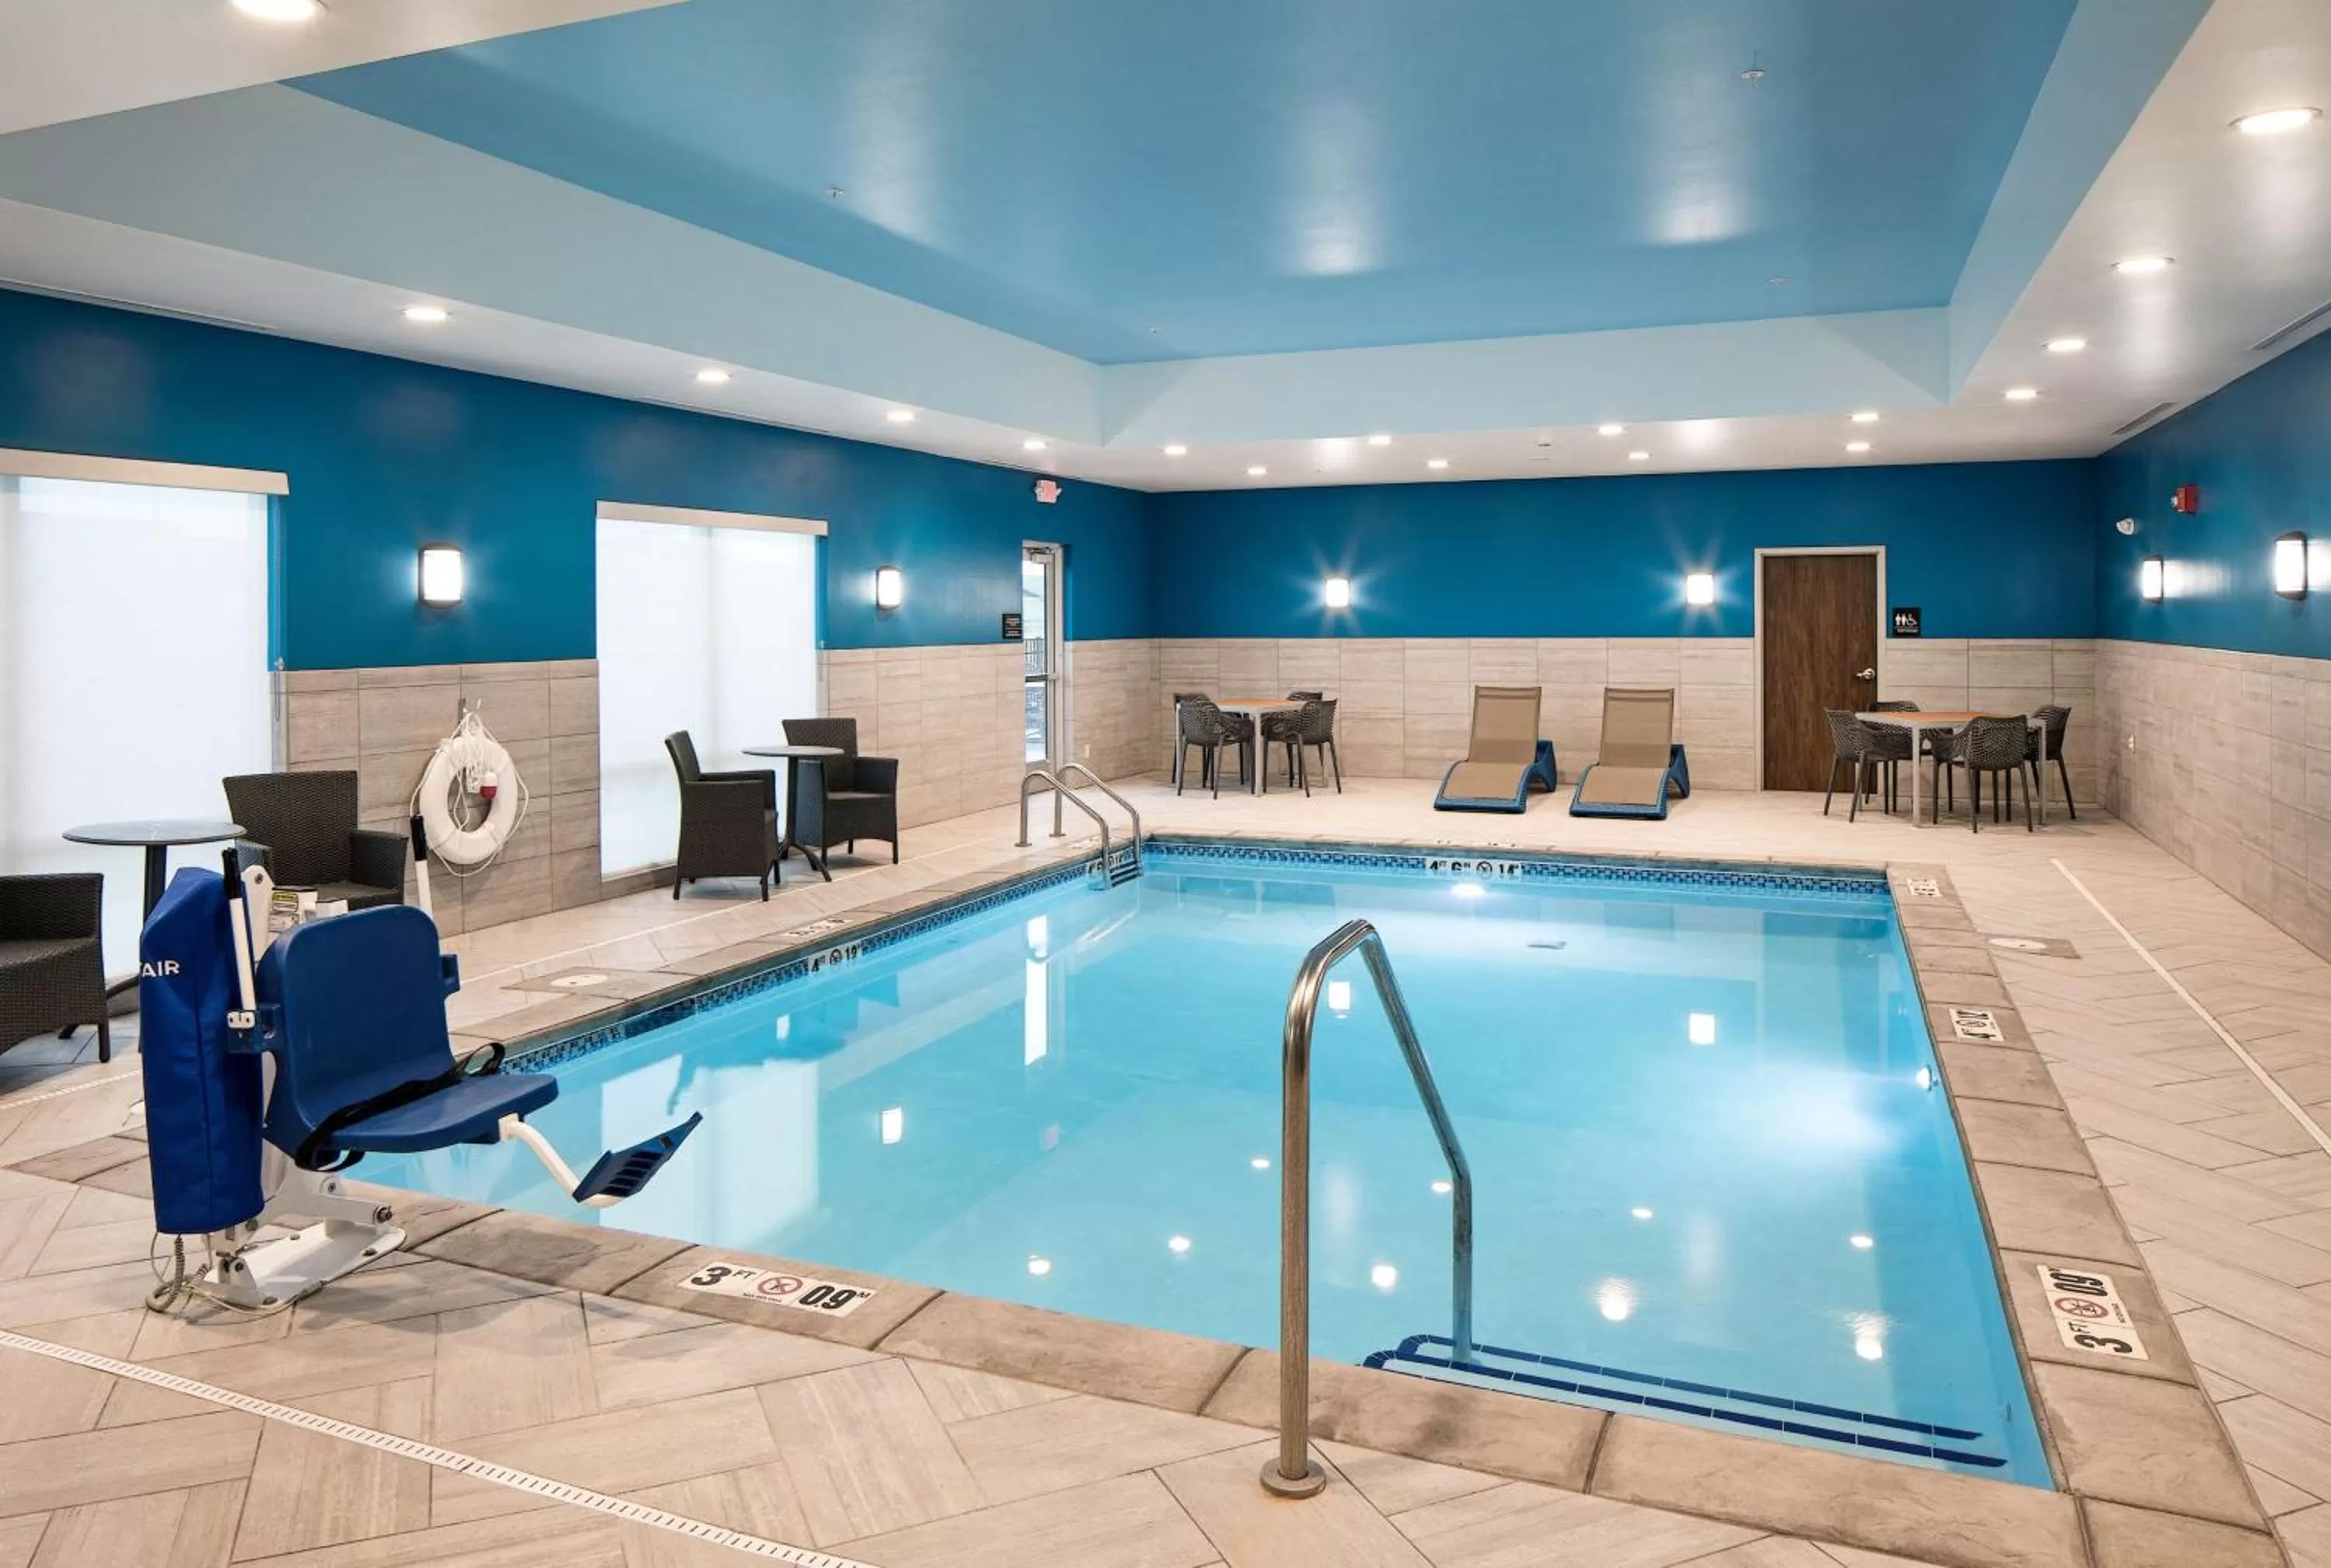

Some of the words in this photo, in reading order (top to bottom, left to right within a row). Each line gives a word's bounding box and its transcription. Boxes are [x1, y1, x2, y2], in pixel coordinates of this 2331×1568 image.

[140, 960, 180, 977] AIR
[691, 1266, 732, 1286] 3
[733, 1270, 757, 1279] FT
[2068, 1321, 2091, 1333] FT
[2074, 1334, 2133, 1354] 3
